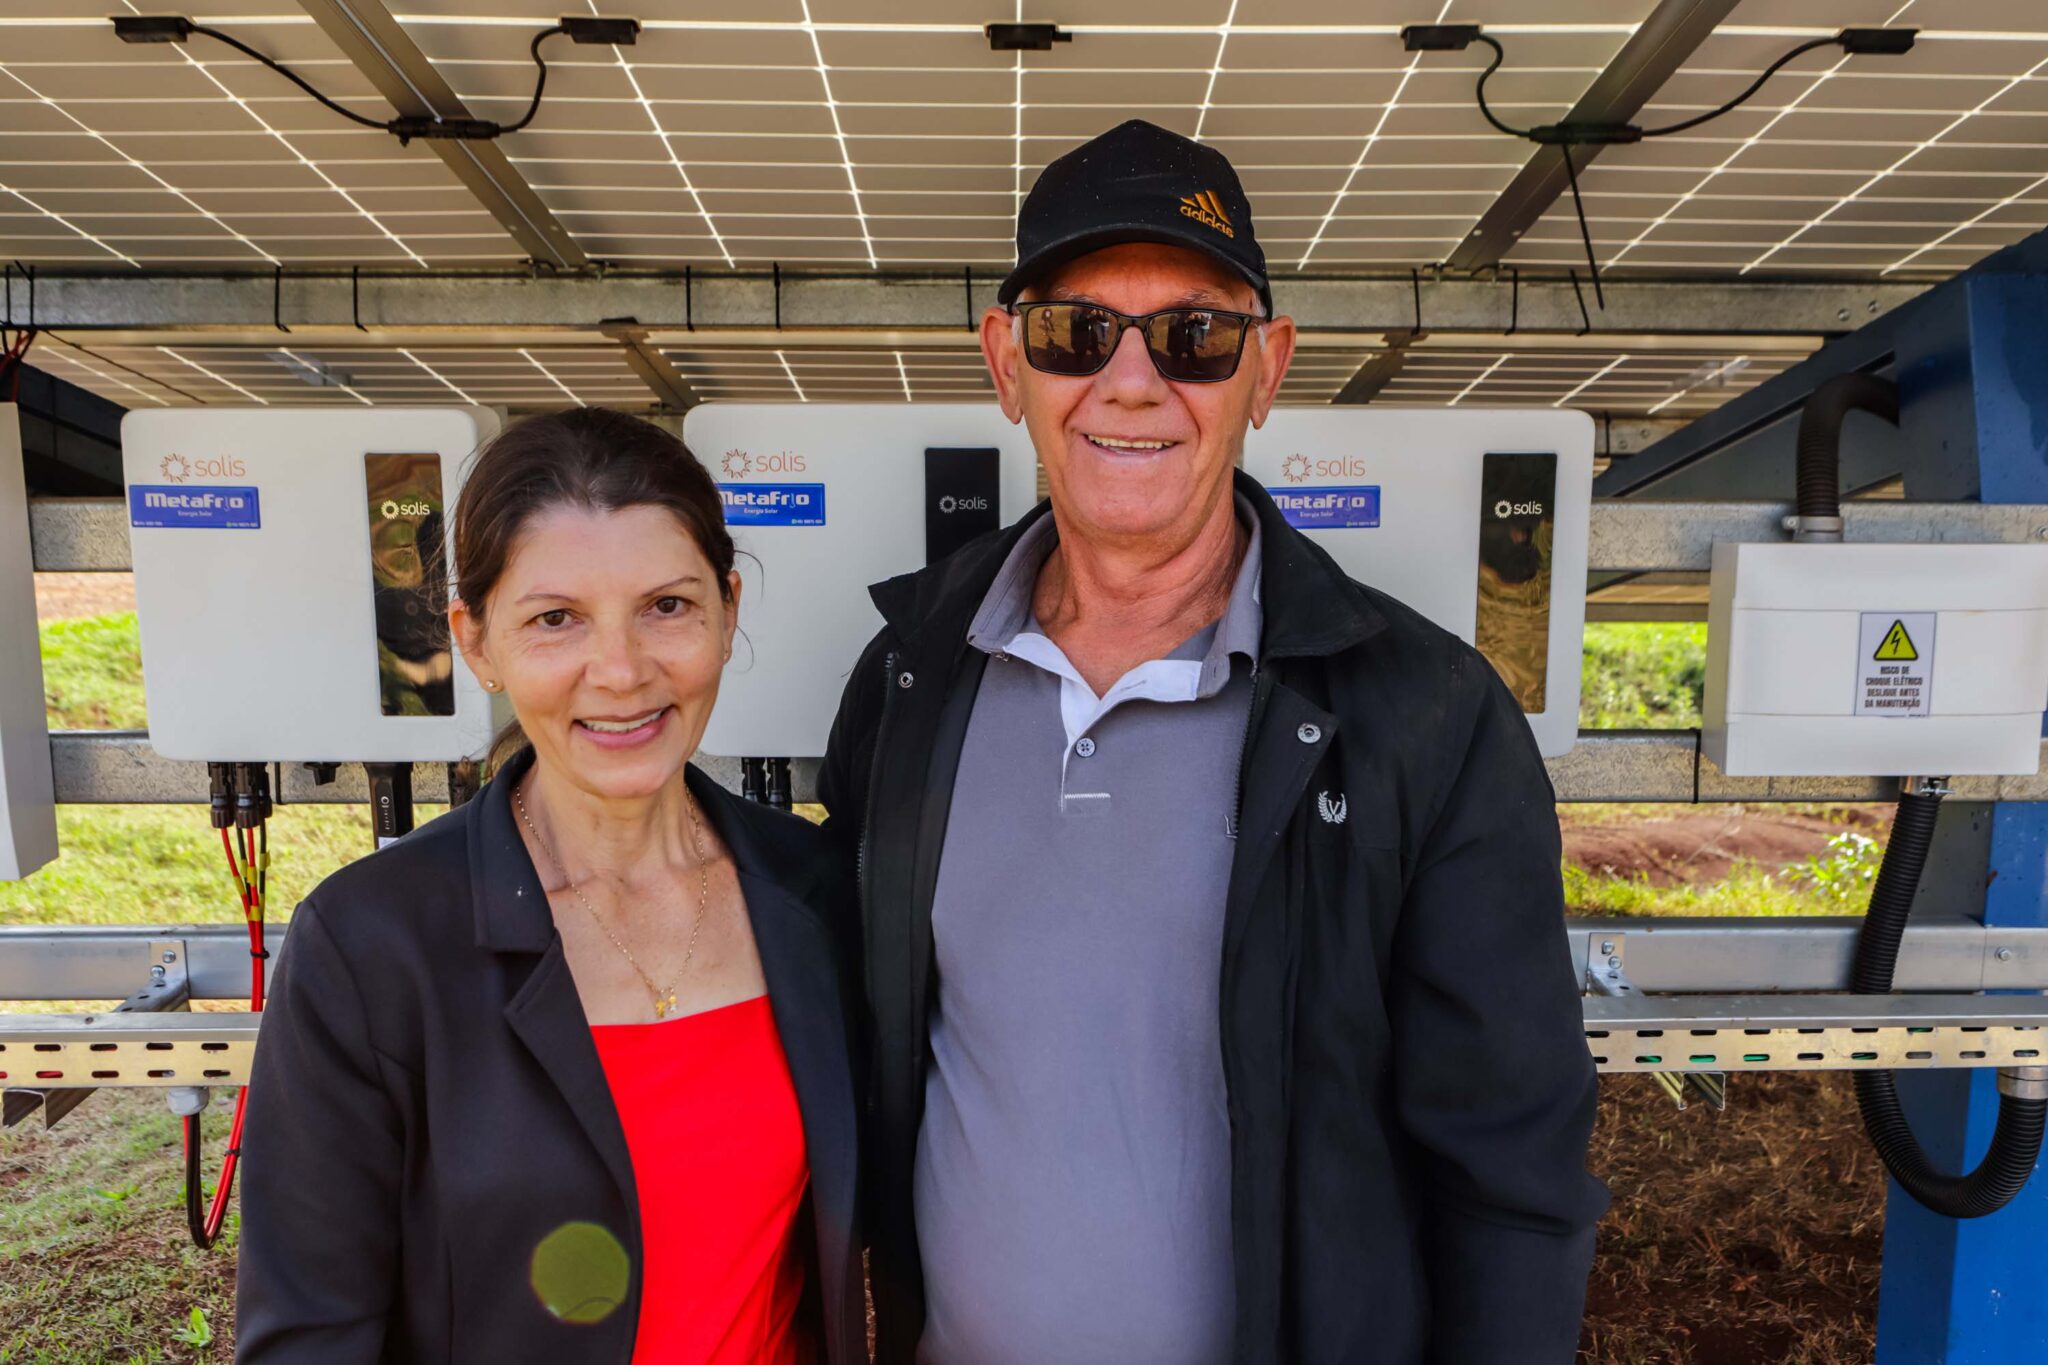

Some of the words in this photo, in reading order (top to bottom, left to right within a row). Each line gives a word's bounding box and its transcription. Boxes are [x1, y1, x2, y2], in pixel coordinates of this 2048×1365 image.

[1179, 205, 1235, 239] adidas
[194, 455, 246, 478] solis
[756, 451, 806, 473] solis
[1315, 456, 1366, 477] solis
[400, 501, 430, 516] solis
[958, 496, 988, 511] solis
[1513, 501, 1543, 515] solis
[743, 508, 764, 516] Energia
[1880, 666, 1900, 675] RISCO
[1901, 666, 1910, 674] DE
[1865, 677, 1891, 686] CHOQUE
[1893, 675, 1923, 686] ELÉTRICO
[1867, 688, 1897, 697] DESLIGUE
[1899, 688, 1920, 697] ANTES
[1864, 699, 1874, 708] DA
[1875, 698, 1921, 710] MANUTENÇÃO
[1327, 799, 1342, 816] V
